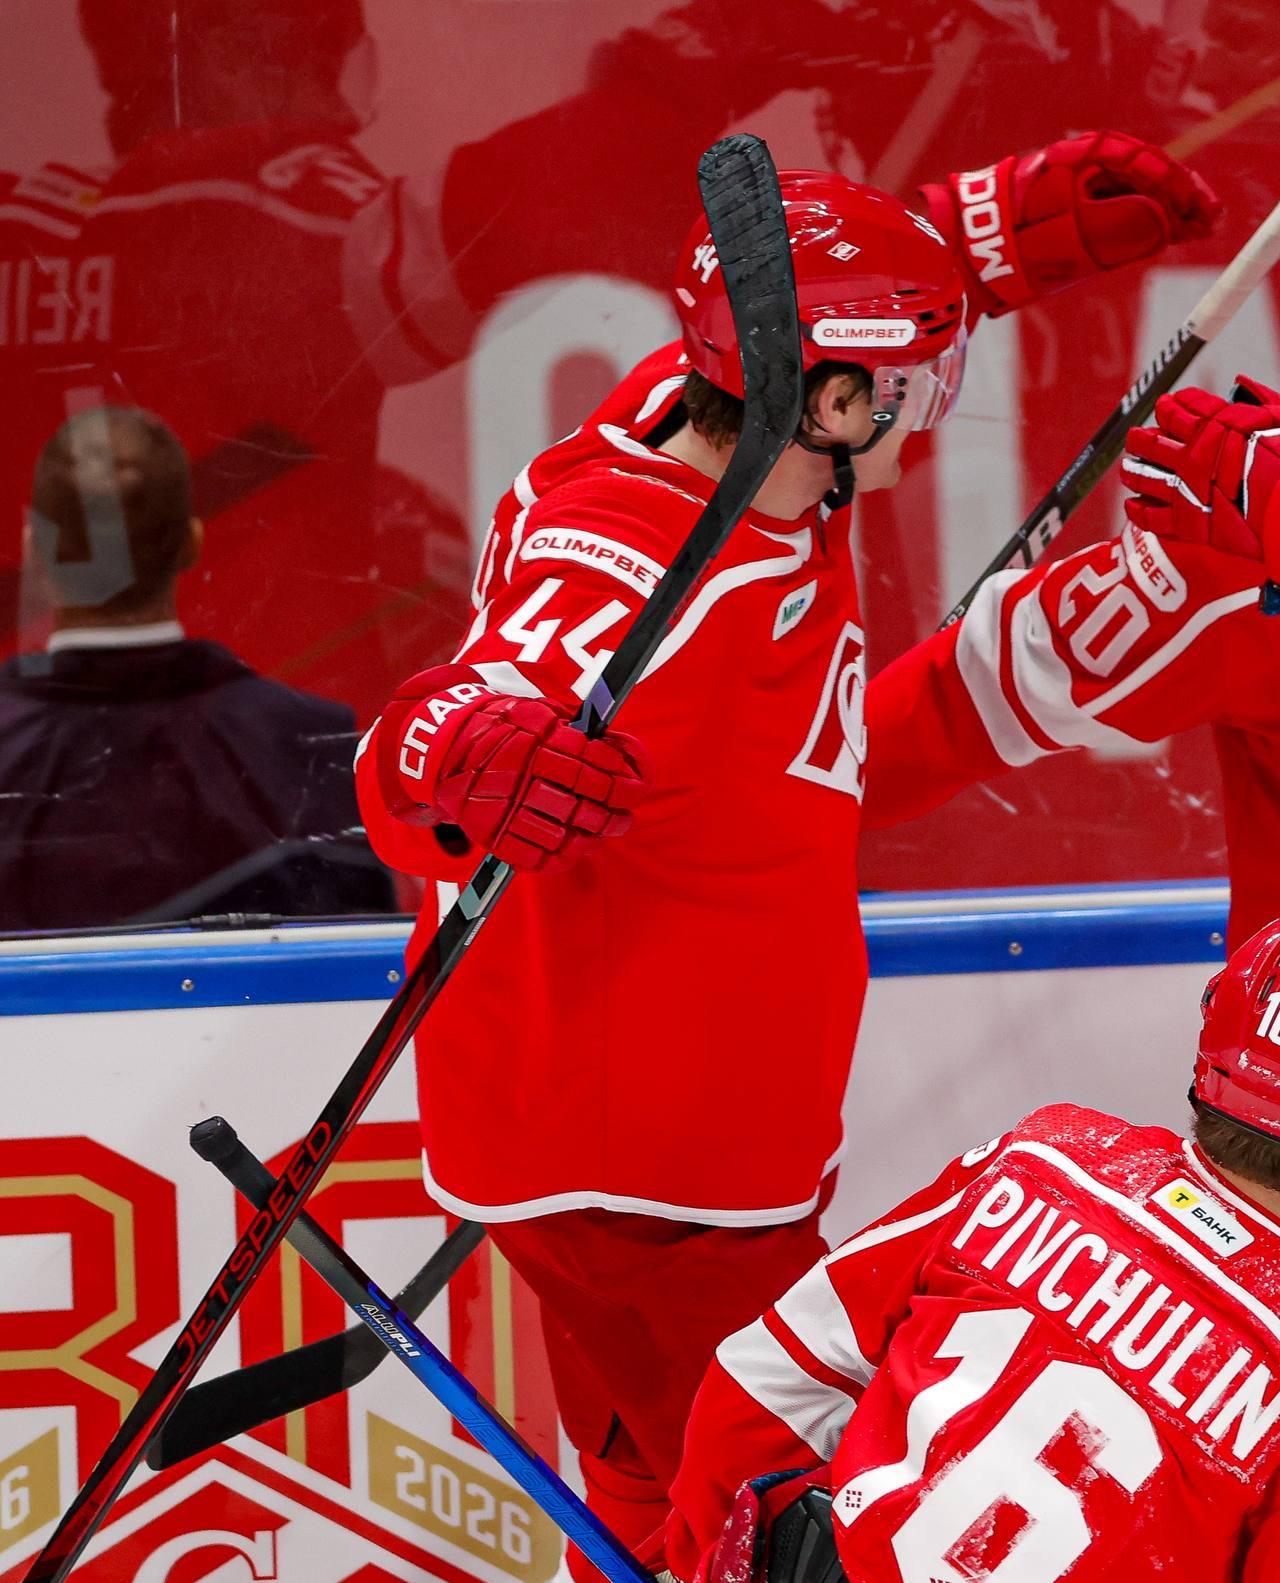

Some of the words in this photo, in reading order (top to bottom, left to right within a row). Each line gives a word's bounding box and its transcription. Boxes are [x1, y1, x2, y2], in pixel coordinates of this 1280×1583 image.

[822, 327, 908, 339] OLIMPBET
[530, 537, 663, 590] OLIMPBET
[1056, 541, 1151, 680] 20
[498, 577, 632, 701] 44
[175, 1120, 334, 1378] JETSPEED
[1190, 1205, 1237, 1246] БАНК
[831, 1305, 1164, 1583] 16
[394, 1445, 533, 1574] 2026
